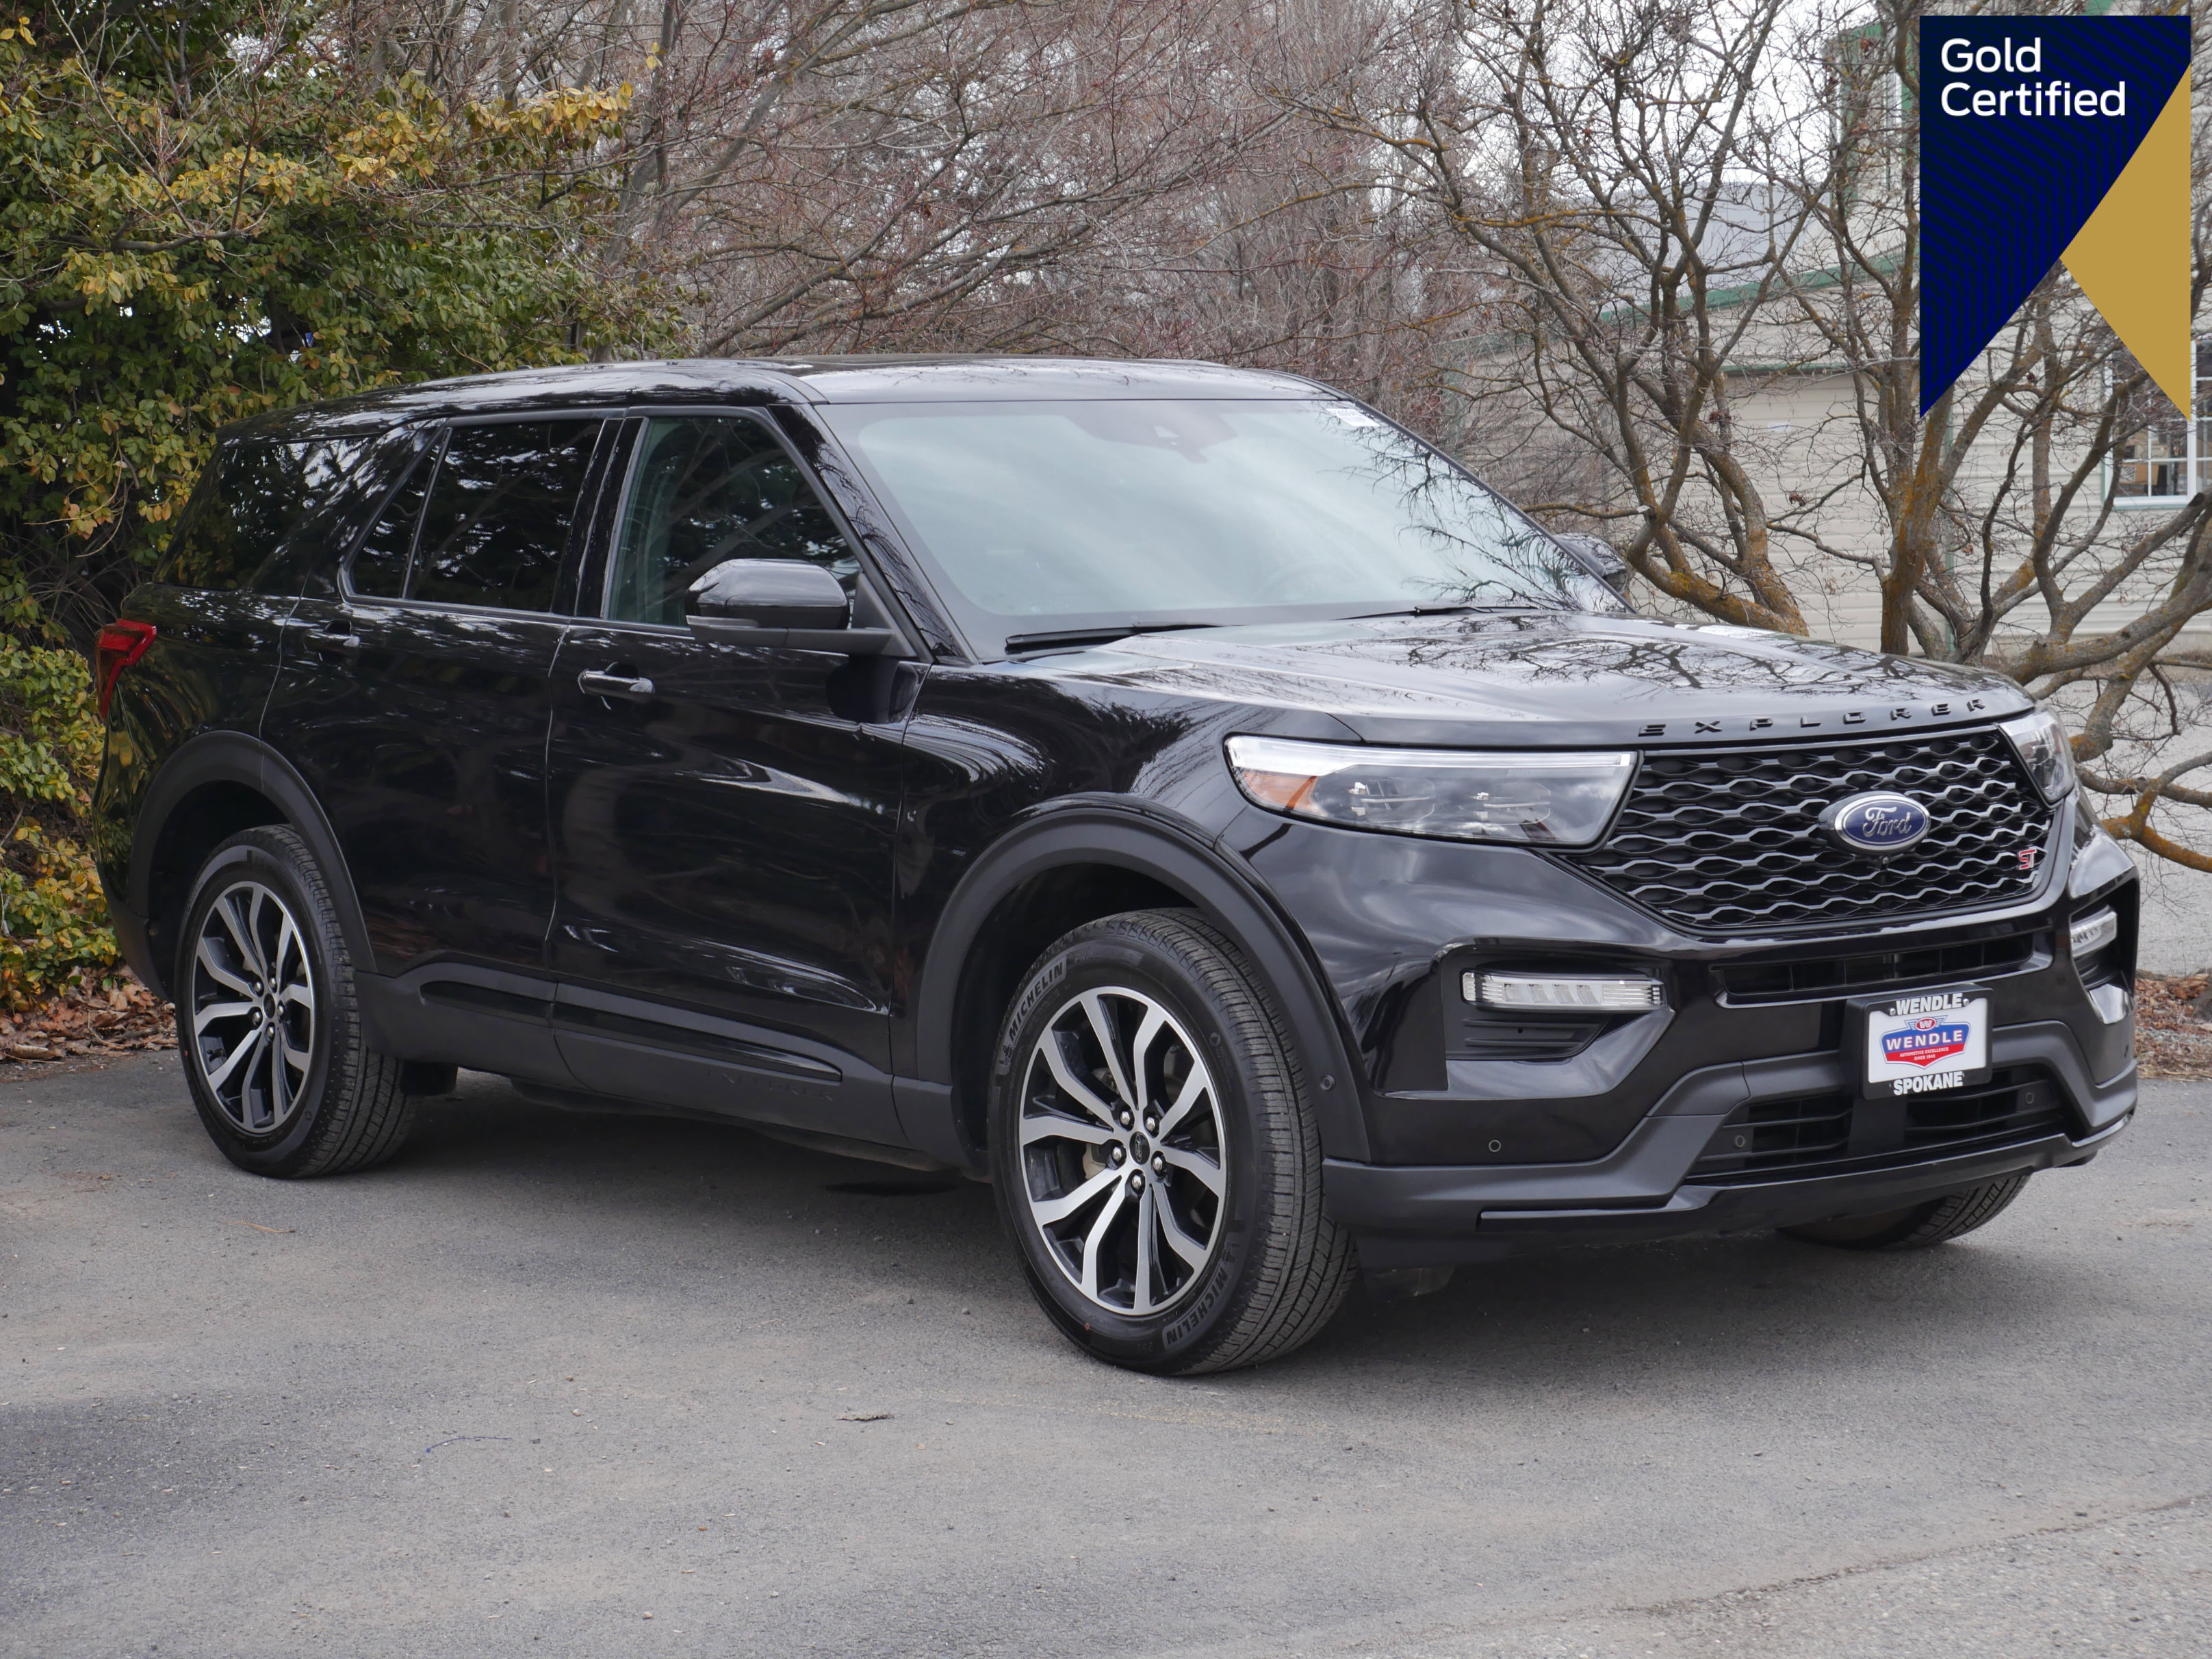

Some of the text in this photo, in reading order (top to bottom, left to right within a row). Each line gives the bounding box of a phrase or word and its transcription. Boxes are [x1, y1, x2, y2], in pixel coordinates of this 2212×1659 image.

[1638, 698, 1986, 737] EXPLORER
[1862, 806, 1912, 837] Ford
[2018, 849, 2037, 870] ST
[1008, 962, 1064, 1042] MICHELIN
[1895, 992, 1964, 1016] WENDLE
[1886, 1029, 1963, 1051] WENDLE
[1893, 1071, 1964, 1096] SPOKANE
[1166, 1268, 1229, 1345] MICHELIN
